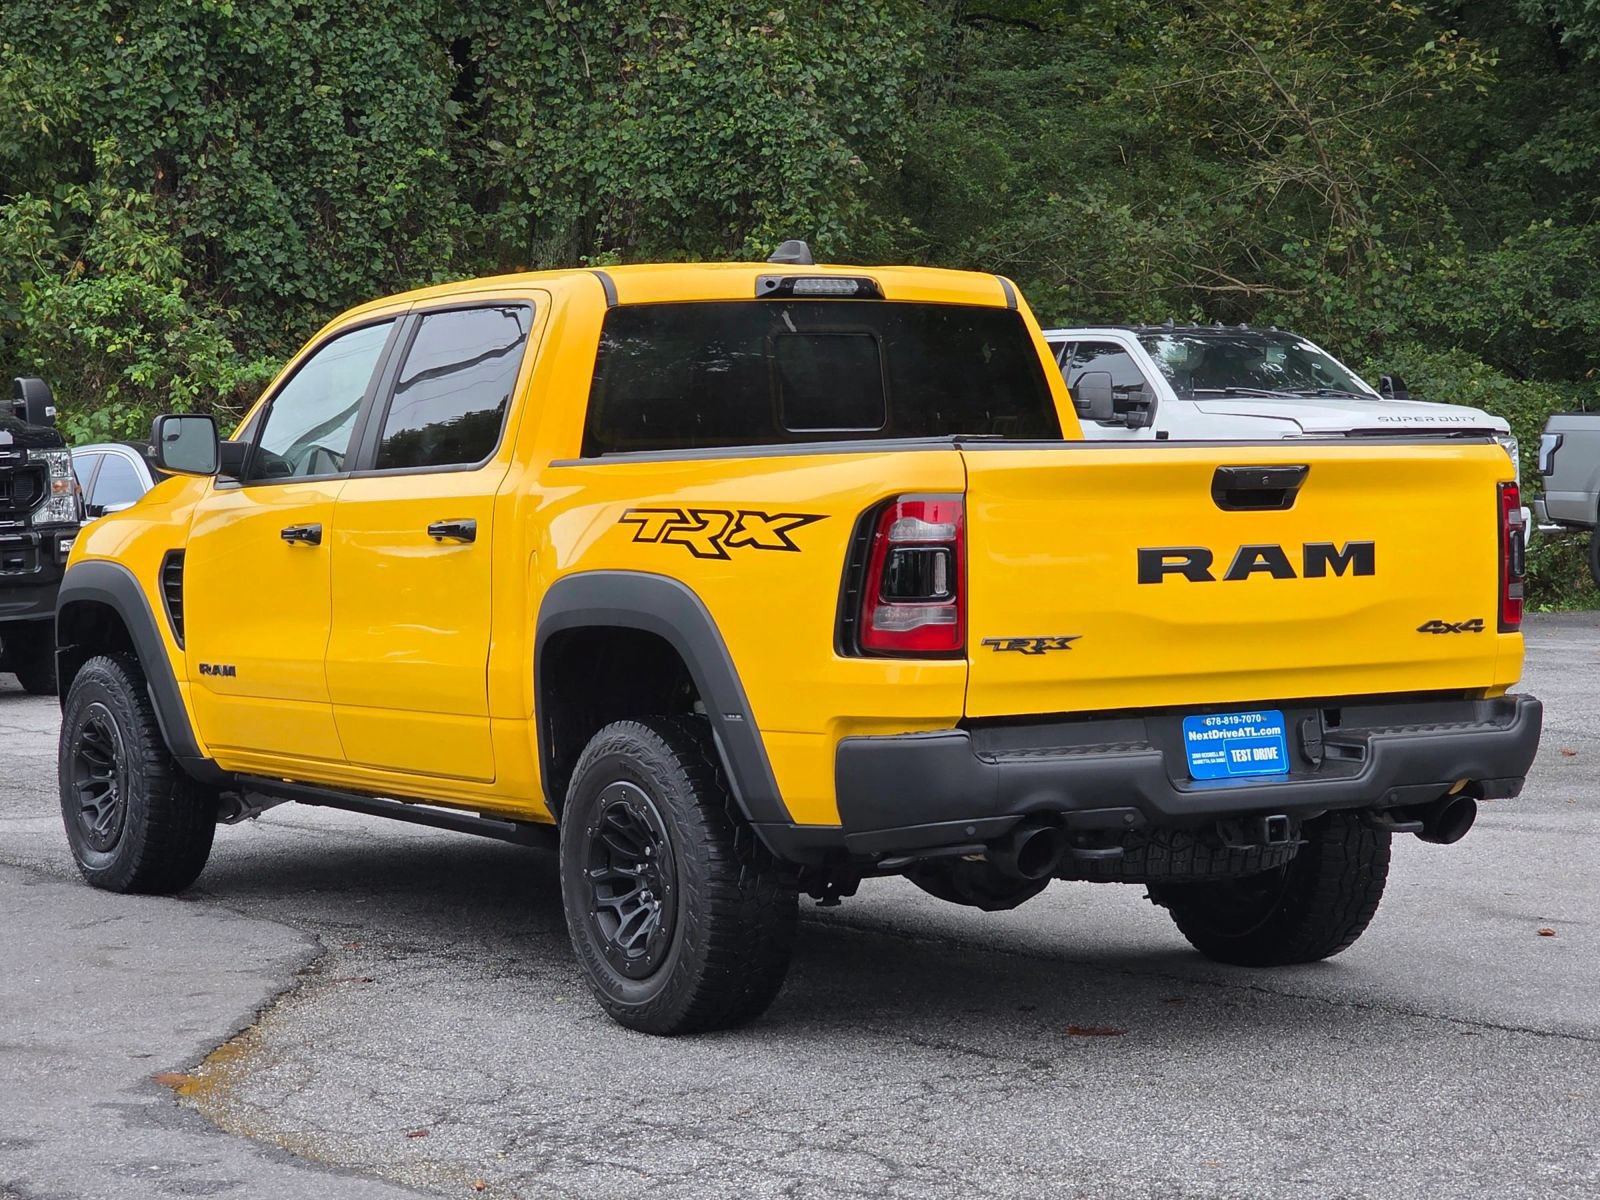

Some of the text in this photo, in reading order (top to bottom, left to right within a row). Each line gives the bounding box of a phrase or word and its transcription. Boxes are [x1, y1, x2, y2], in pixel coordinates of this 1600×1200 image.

[617, 508, 832, 561] TRX
[1137, 541, 1375, 585] RAM
[1416, 618, 1486, 635] 4x4
[980, 635, 1083, 655] TRX
[199, 663, 236, 678] RAM
[1205, 714, 1262, 726] 678-819-7070
[1189, 727, 1281, 741] NextDriveATL.com
[1231, 749, 1251, 762] TEST
[1253, 747, 1278, 760] DRIVE
